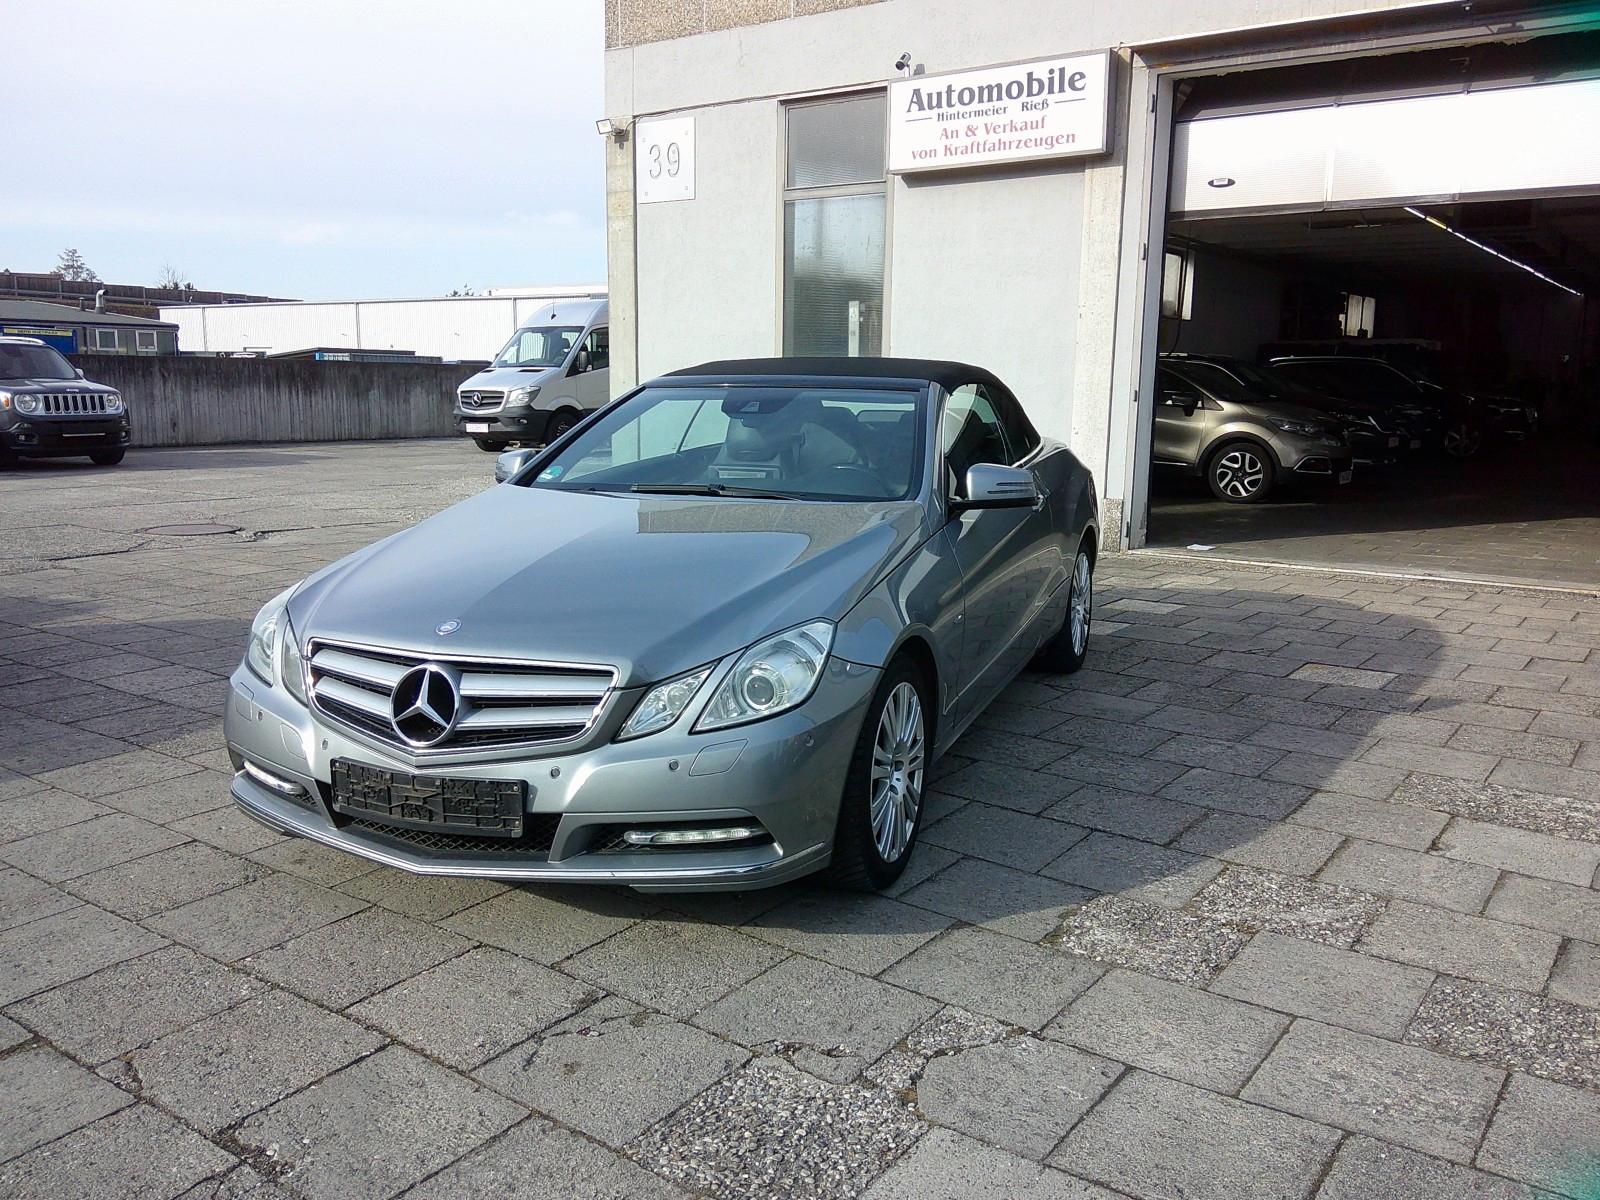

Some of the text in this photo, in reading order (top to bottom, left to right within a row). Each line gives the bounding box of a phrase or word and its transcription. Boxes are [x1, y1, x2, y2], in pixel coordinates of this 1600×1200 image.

[906, 66, 1087, 113] Automobile
[937, 98, 1049, 122] Hintermeier Rieß
[940, 114, 1047, 141] An & Verkauf
[911, 133, 1076, 160] von Kraftfahrzeugen
[649, 142, 680, 179] 39
